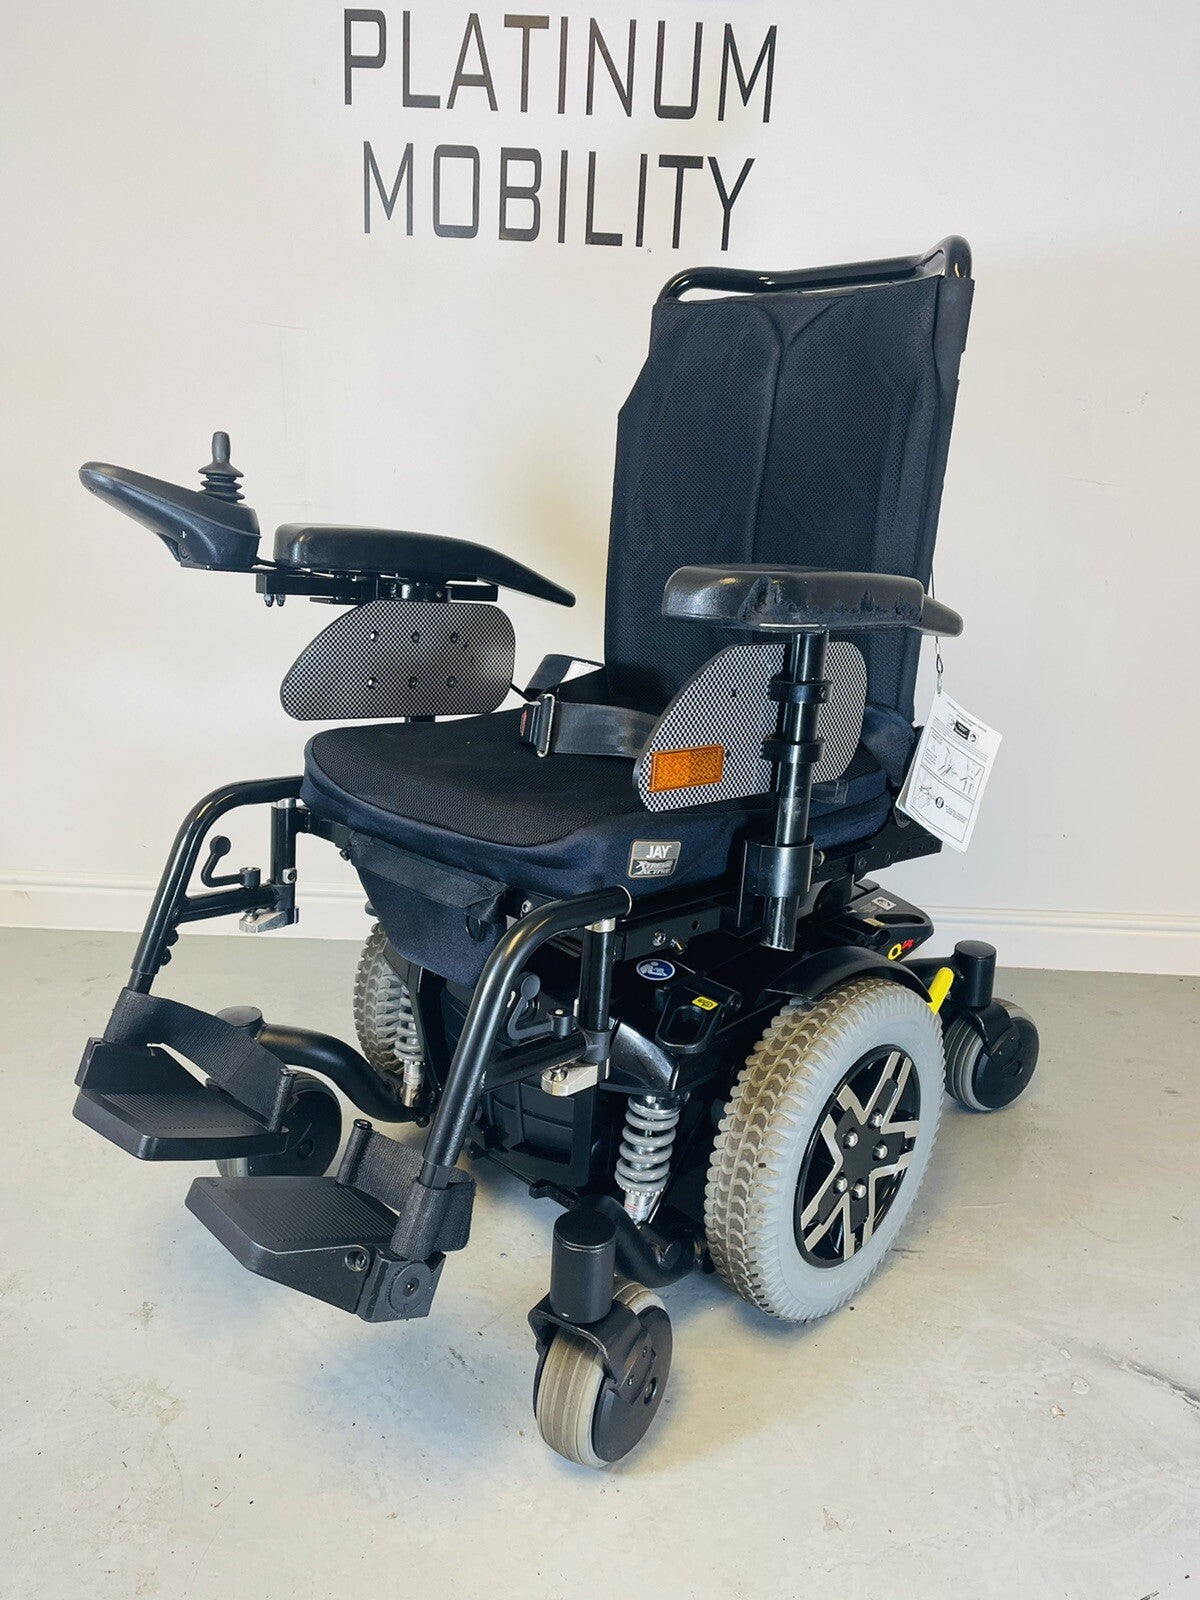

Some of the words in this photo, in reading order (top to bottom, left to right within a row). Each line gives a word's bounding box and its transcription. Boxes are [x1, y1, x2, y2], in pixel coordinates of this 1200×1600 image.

[344, 8, 778, 124] PLATINUM
[363, 140, 756, 252] MOBILITY
[646, 845, 672, 859] JAY
